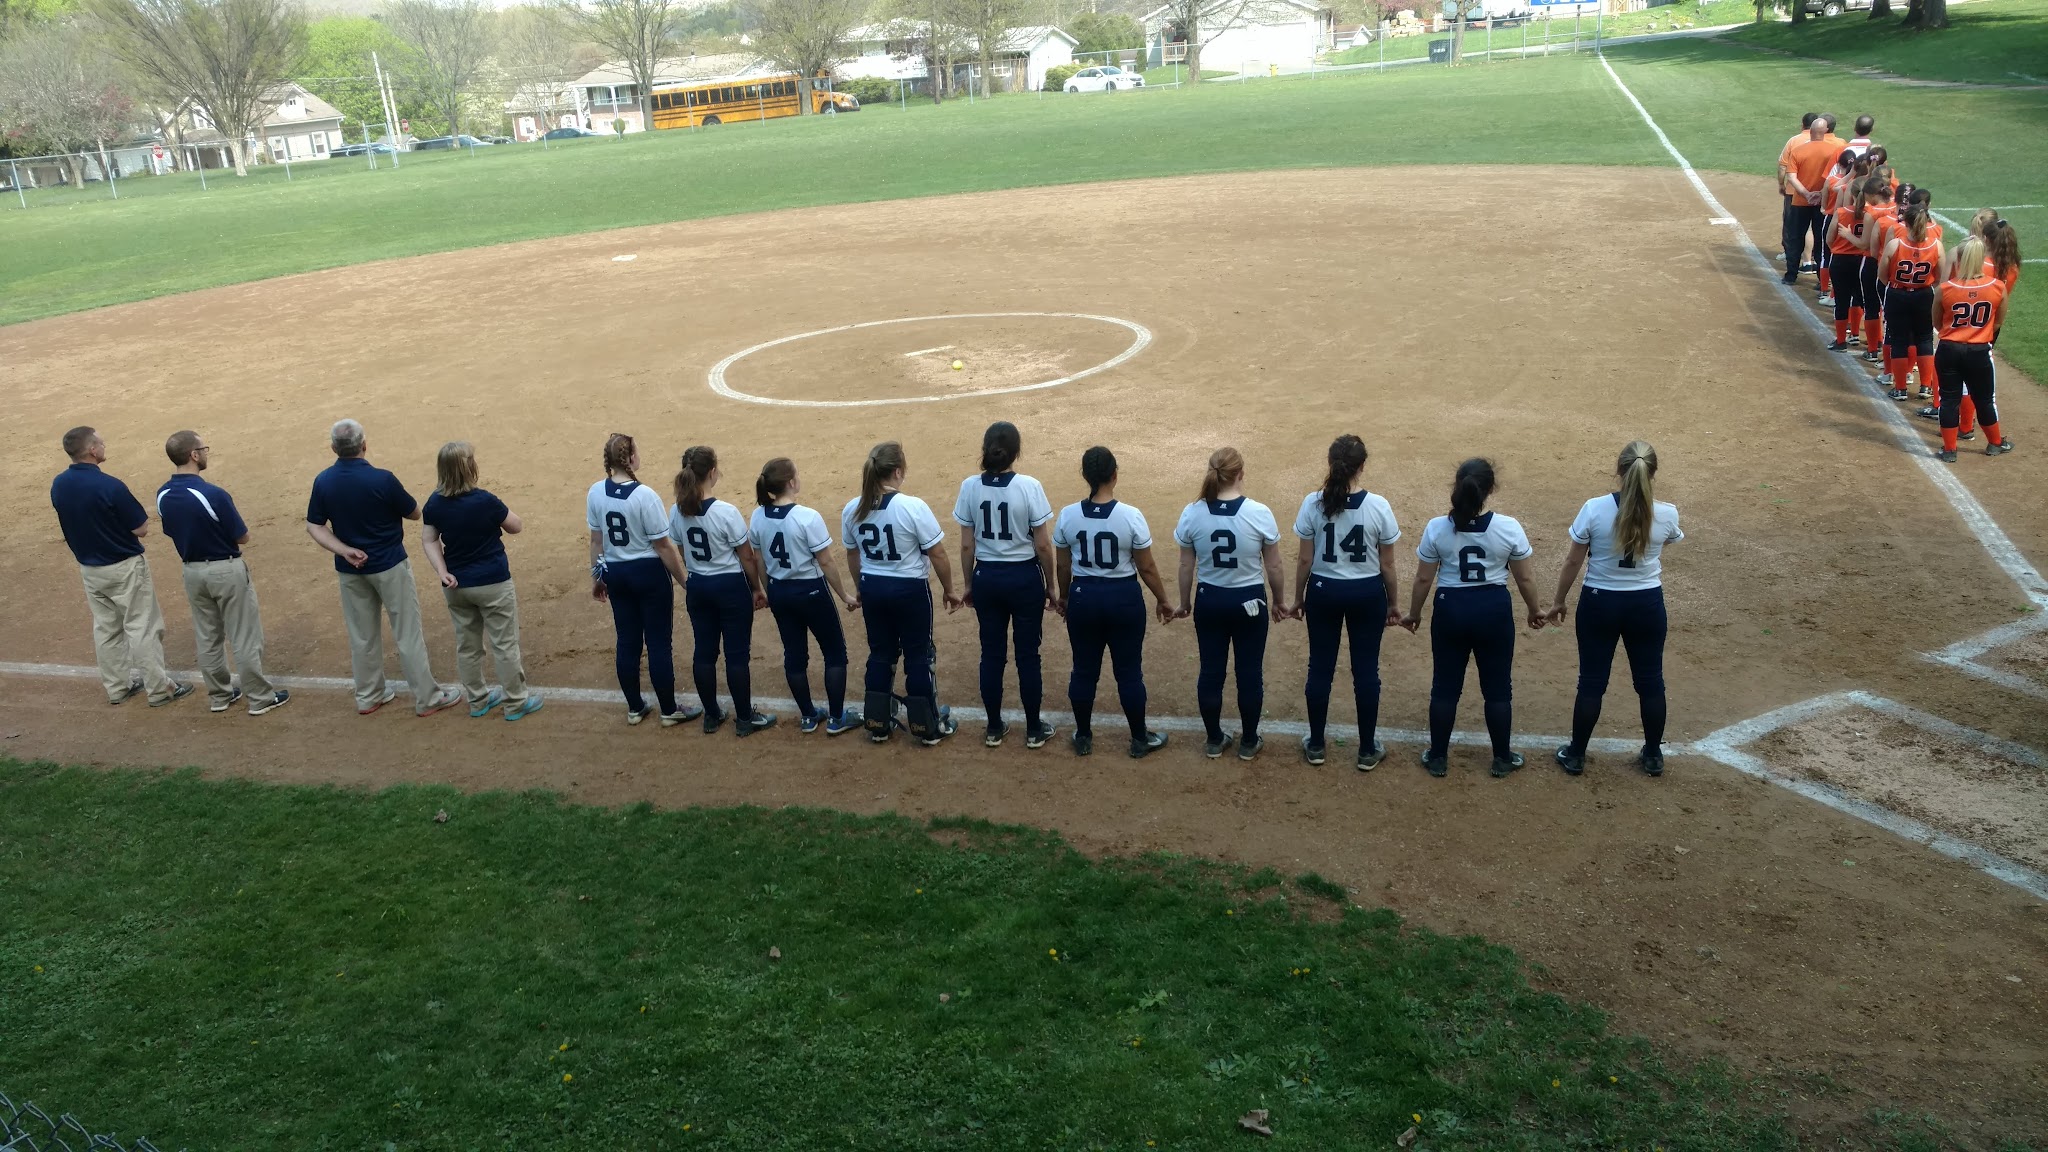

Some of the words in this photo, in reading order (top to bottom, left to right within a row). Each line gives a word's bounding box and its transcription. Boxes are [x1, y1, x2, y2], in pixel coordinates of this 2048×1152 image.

[1895, 259, 1931, 284] 22
[1951, 301, 1992, 329] 20
[605, 511, 630, 547] 8
[979, 500, 1013, 541] 11
[687, 526, 713, 562] 9
[769, 531, 792, 569] 4
[858, 523, 902, 561] 21
[1075, 530, 1120, 570] 10
[1210, 529, 1239, 569] 2
[1321, 522, 1368, 563] 14
[1458, 545, 1487, 583] 6
